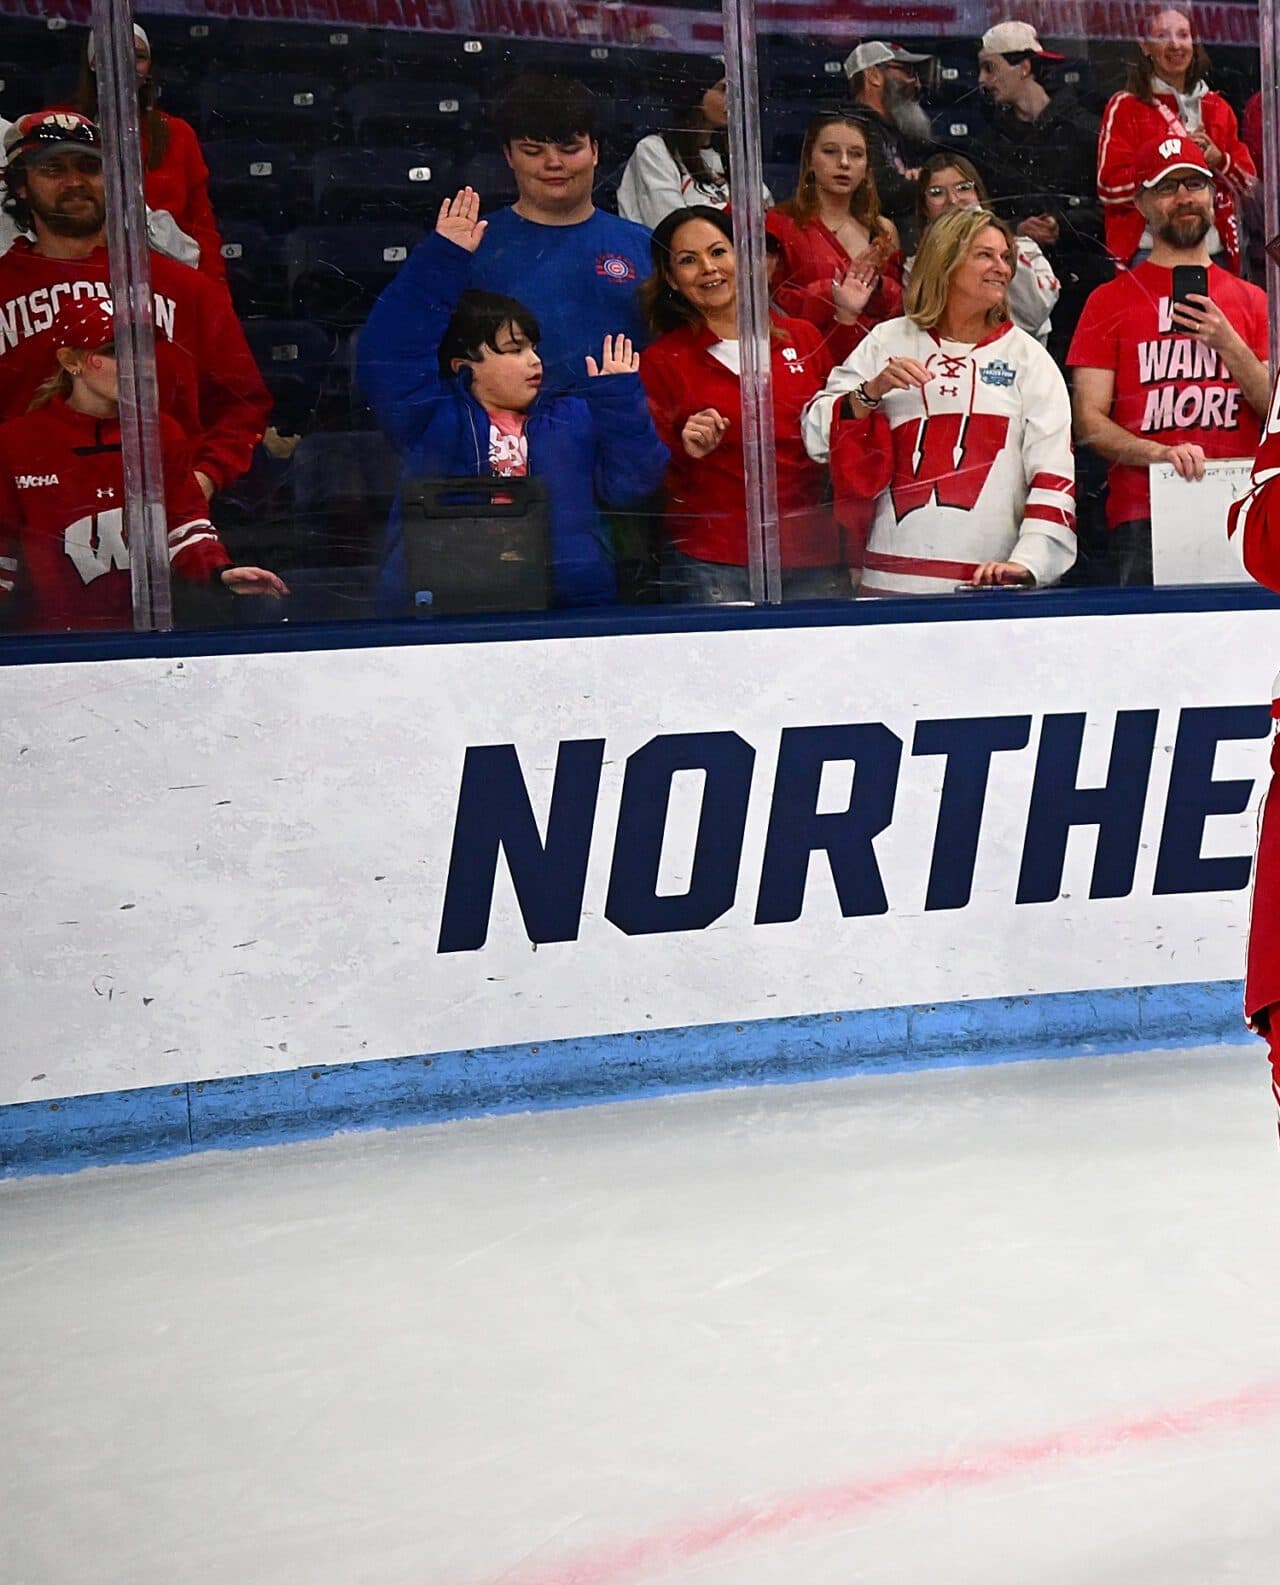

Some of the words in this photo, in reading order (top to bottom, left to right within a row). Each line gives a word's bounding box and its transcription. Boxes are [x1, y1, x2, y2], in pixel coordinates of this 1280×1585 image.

[1158, 138, 1182, 159] W
[0, 281, 177, 356] WISCN
[1140, 385, 1241, 431] MORE
[15, 474, 60, 488] WCHA
[890, 412, 1010, 526] W
